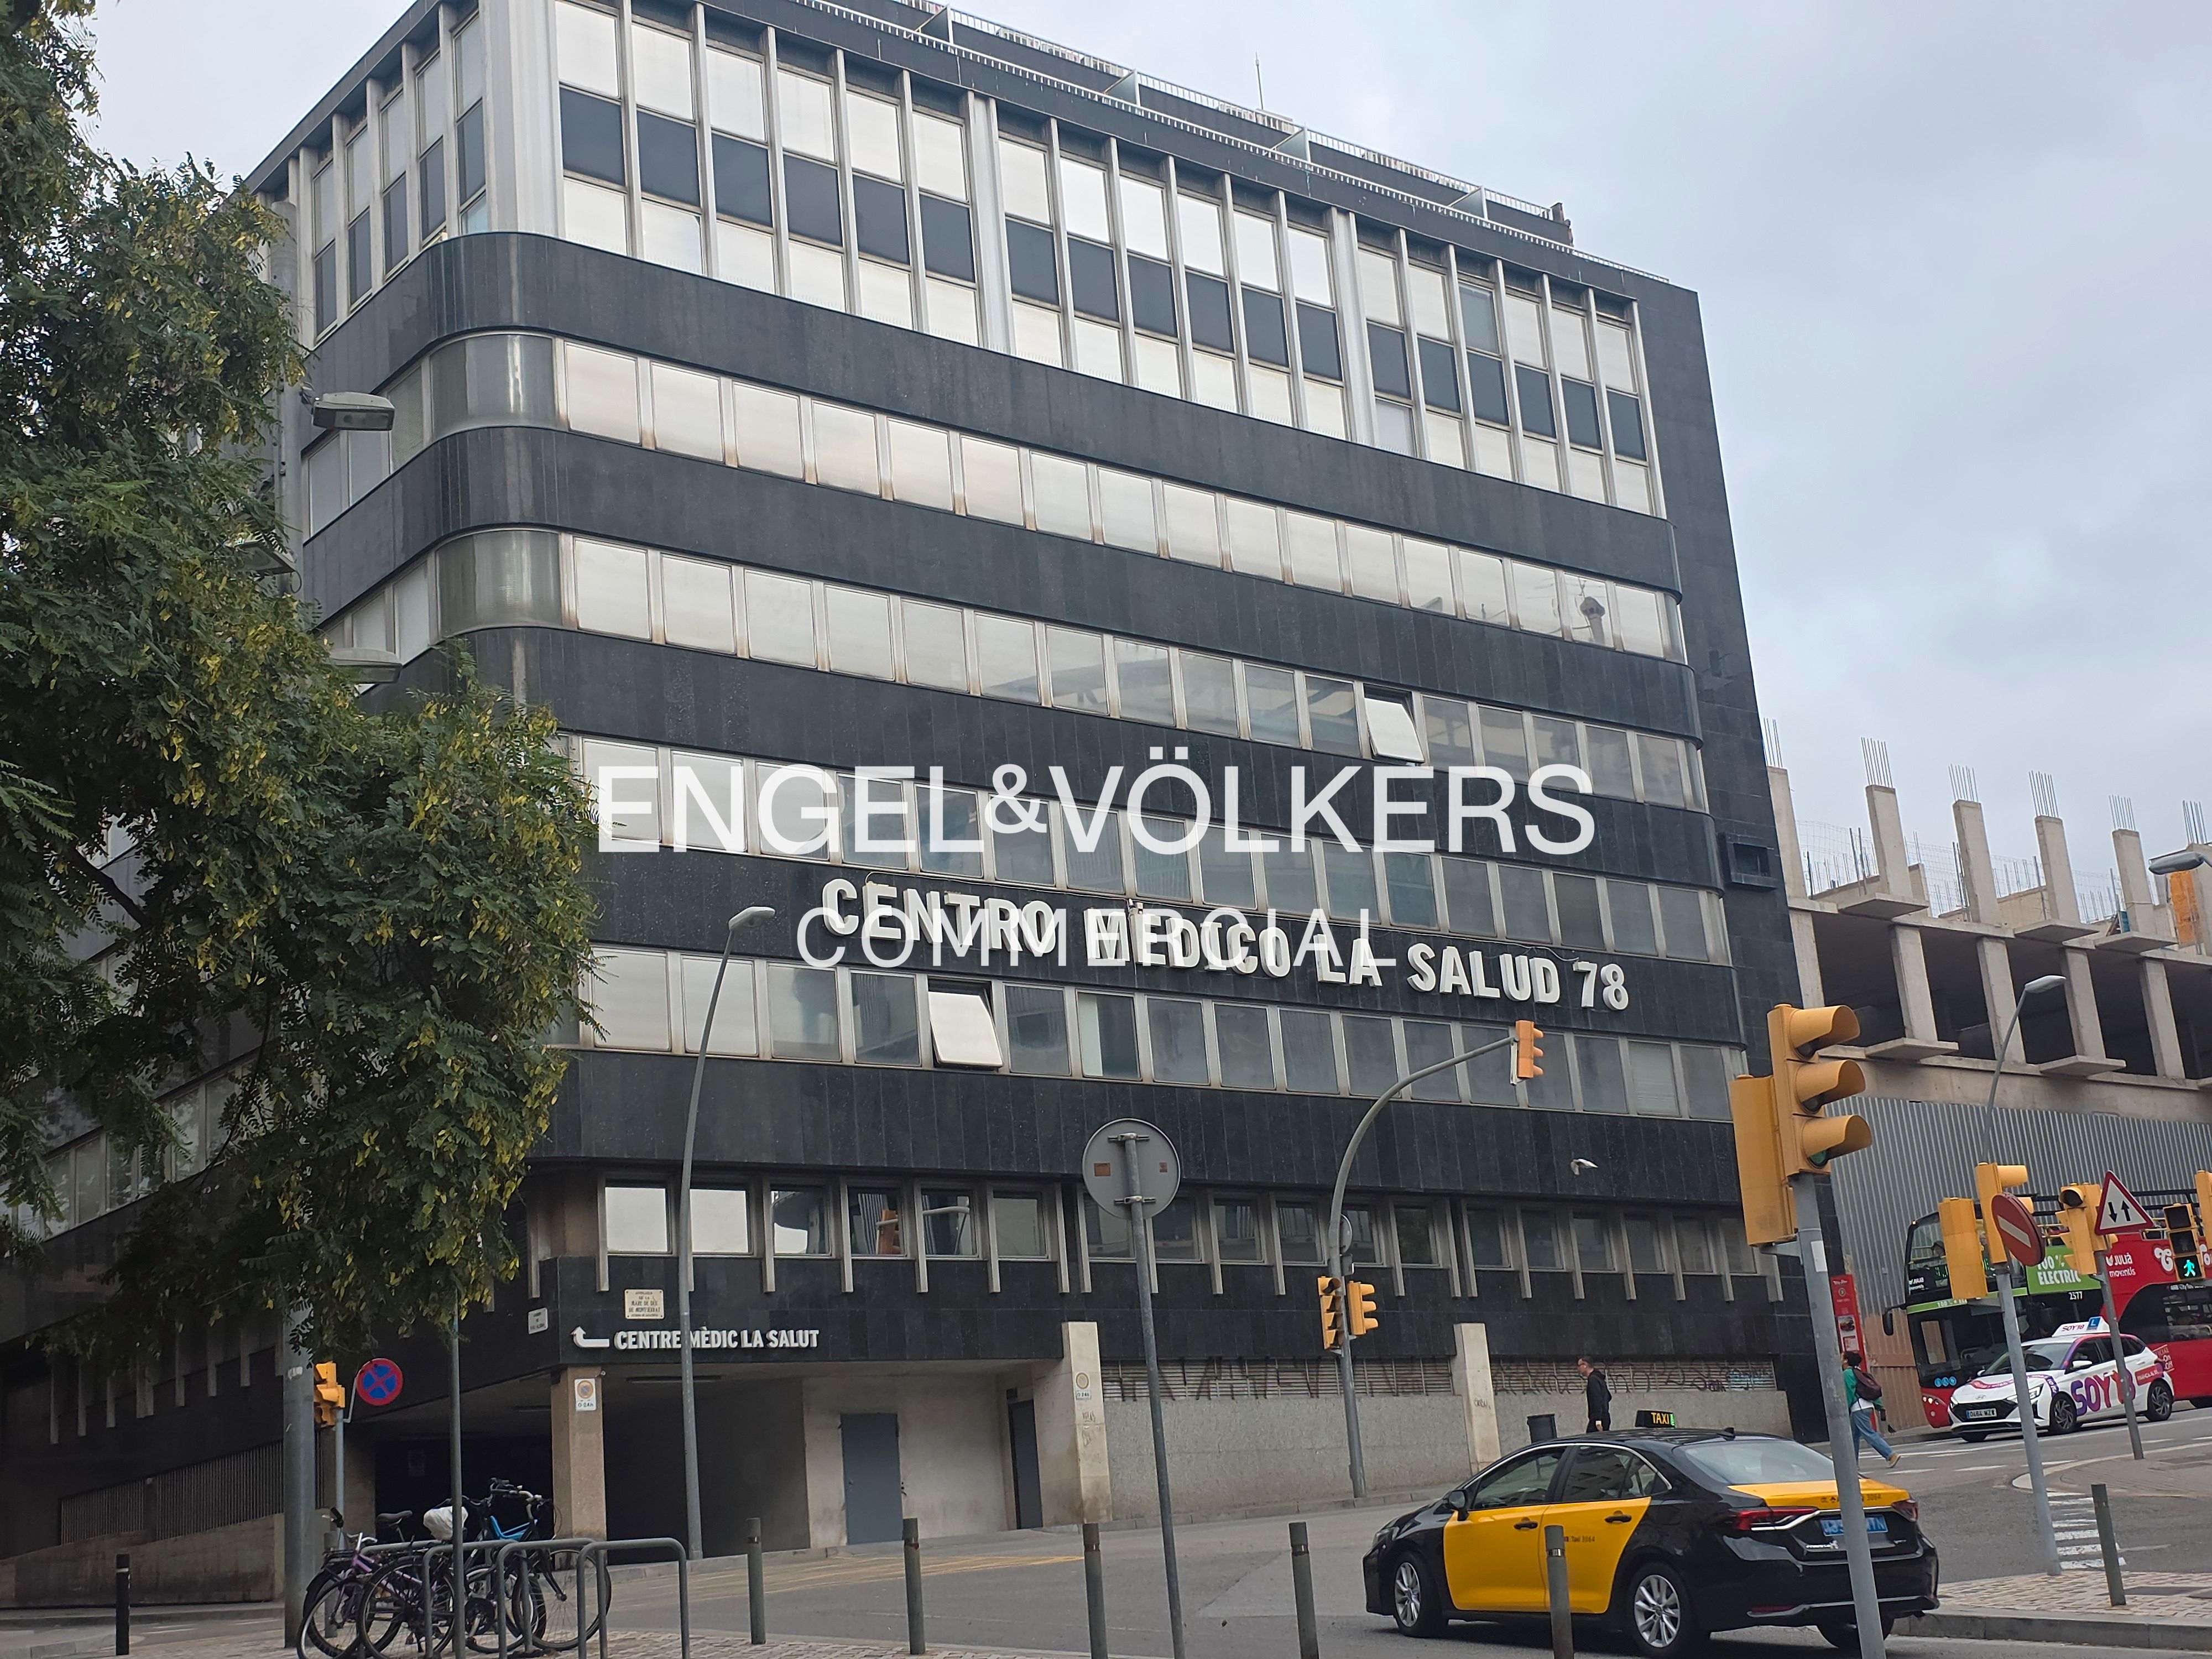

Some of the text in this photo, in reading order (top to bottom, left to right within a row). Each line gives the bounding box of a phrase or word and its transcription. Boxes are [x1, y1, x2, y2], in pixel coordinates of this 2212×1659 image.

[822, 879, 1056, 953] CENTRO
[1314, 935, 1383, 987] LA
[1407, 943, 1560, 1004] SALUD
[1574, 961, 1629, 1011] 78
[2037, 1269, 2081, 1285] ELECTRIC
[614, 1326, 819, 1350] CENTRE MÈDIC LA SALUT
[1651, 1412, 1670, 1425] TAXI
